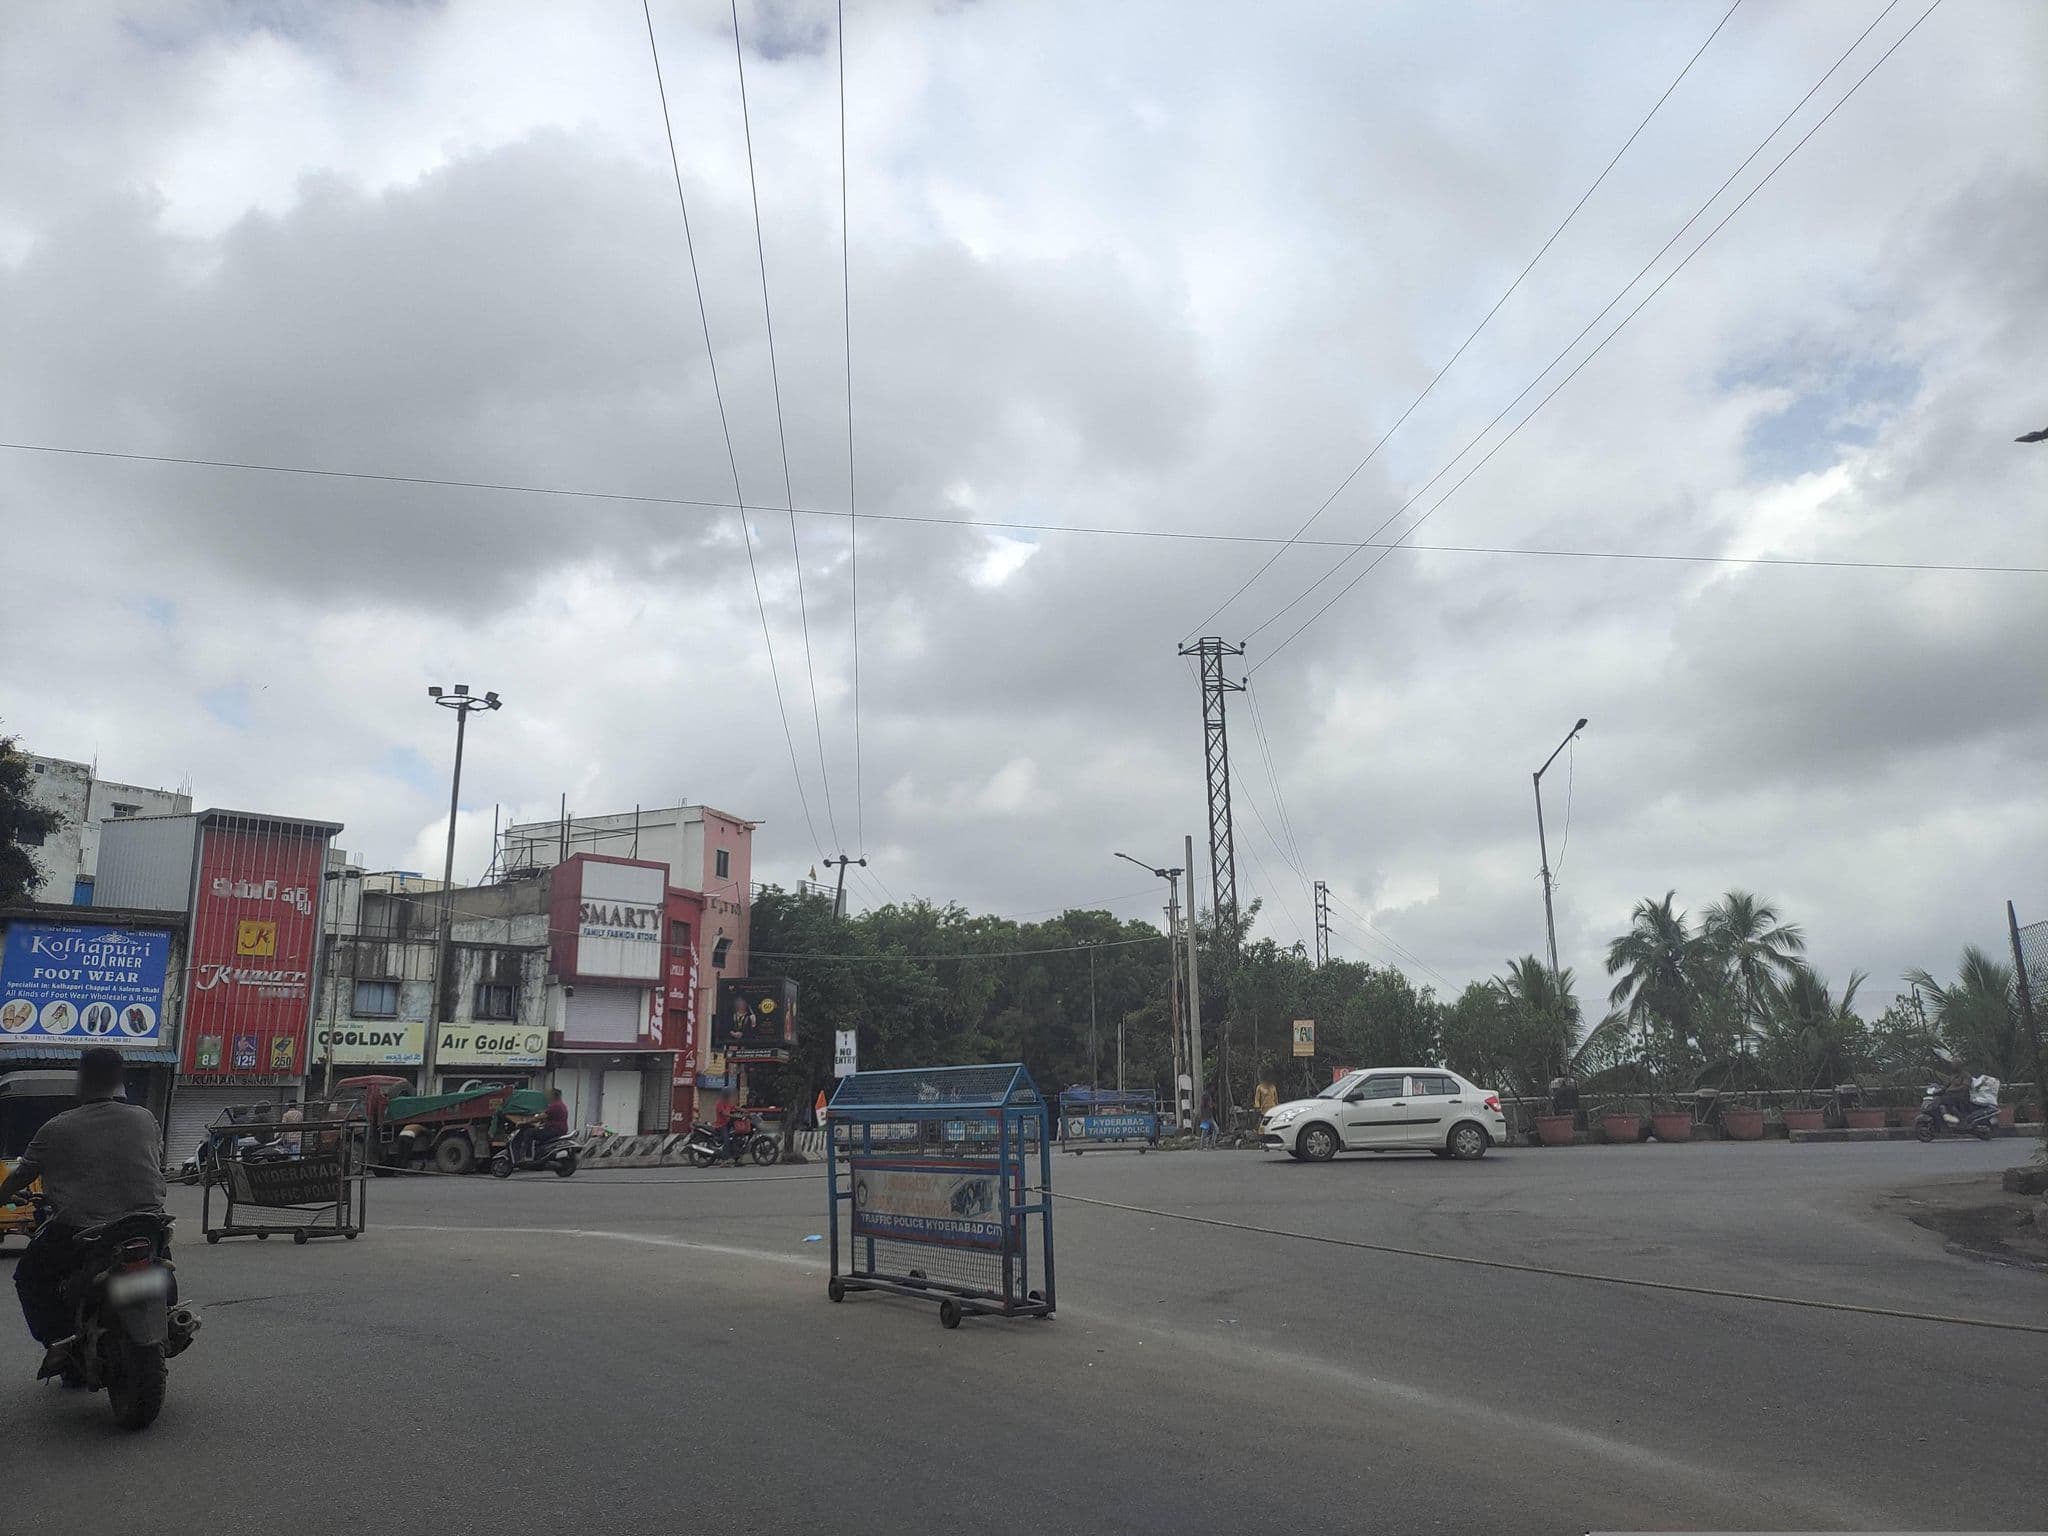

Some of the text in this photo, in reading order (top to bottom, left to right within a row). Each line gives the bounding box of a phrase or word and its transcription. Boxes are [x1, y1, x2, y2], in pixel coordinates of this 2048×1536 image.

[579, 903, 663, 930] SMARTY
[583, 927, 657, 941] FAMILY FASHION STORE
[32, 935, 152, 962] Kolhapuri
[82, 953, 143, 969] CORNER
[33, 967, 138, 983] FOOT WEAR
[85, 984, 111, 992] Chappal
[18, 990, 39, 998] Kinds
[51, 991, 68, 999] Foot
[90, 992, 127, 1001] Wholesale
[318, 1031, 404, 1046] COOLDAY
[441, 1034, 469, 1049] Air
[840, 1048, 852, 1056] NO
[237, 1055, 256, 1066] 125
[274, 1057, 292, 1067] 250
[835, 1056, 856, 1065] ENTRY
[1093, 1118, 1145, 1127] HYDERABAD
[1088, 1126, 1150, 1135] TRAFFIC POLICE
[861, 1213, 893, 1226] TRAFFIC
[894, 1216, 925, 1229] POLICE
[926, 1220, 984, 1234] HYDERABAD
